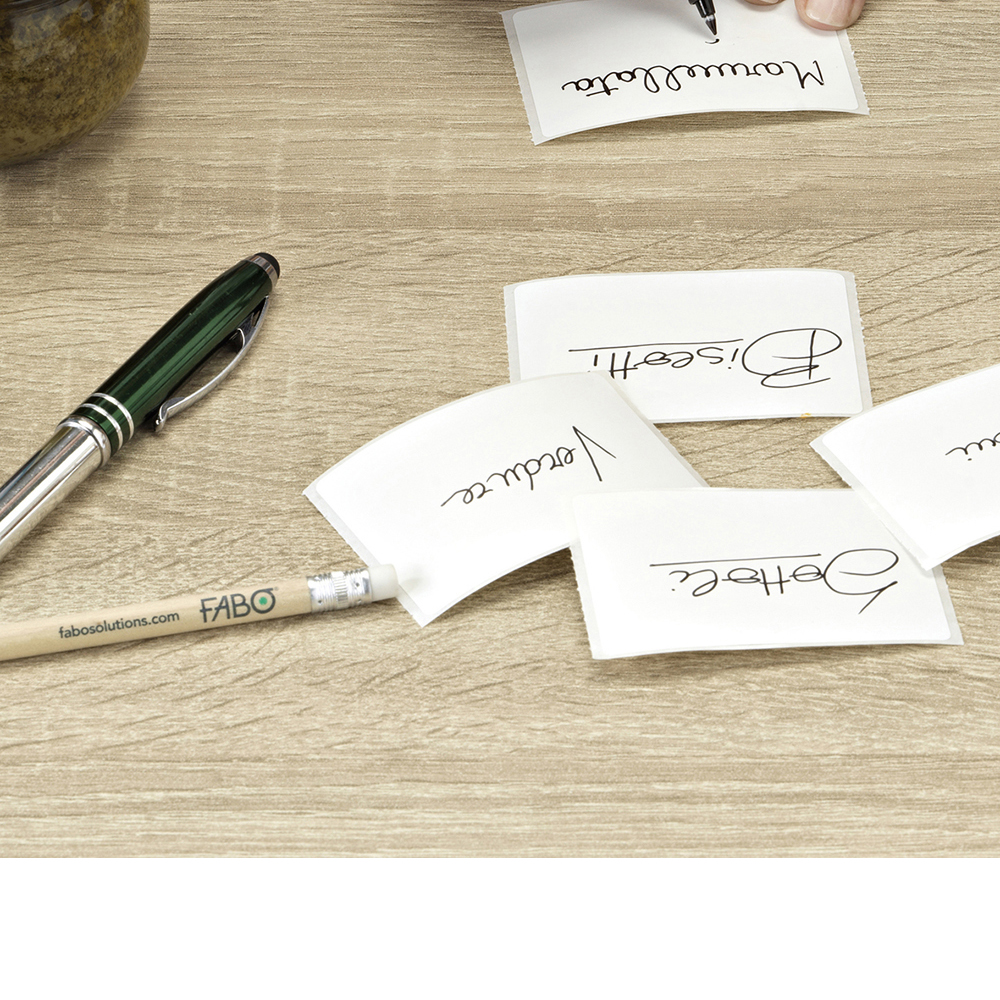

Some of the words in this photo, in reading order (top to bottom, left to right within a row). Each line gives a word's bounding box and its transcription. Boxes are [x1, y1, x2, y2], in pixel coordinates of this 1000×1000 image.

[587, 327, 843, 389] Biscotti
[440, 425, 617, 508] Verdure
[668, 548, 900, 615] Sottoli
[58, 610, 180, 639] fabosolutions.com
